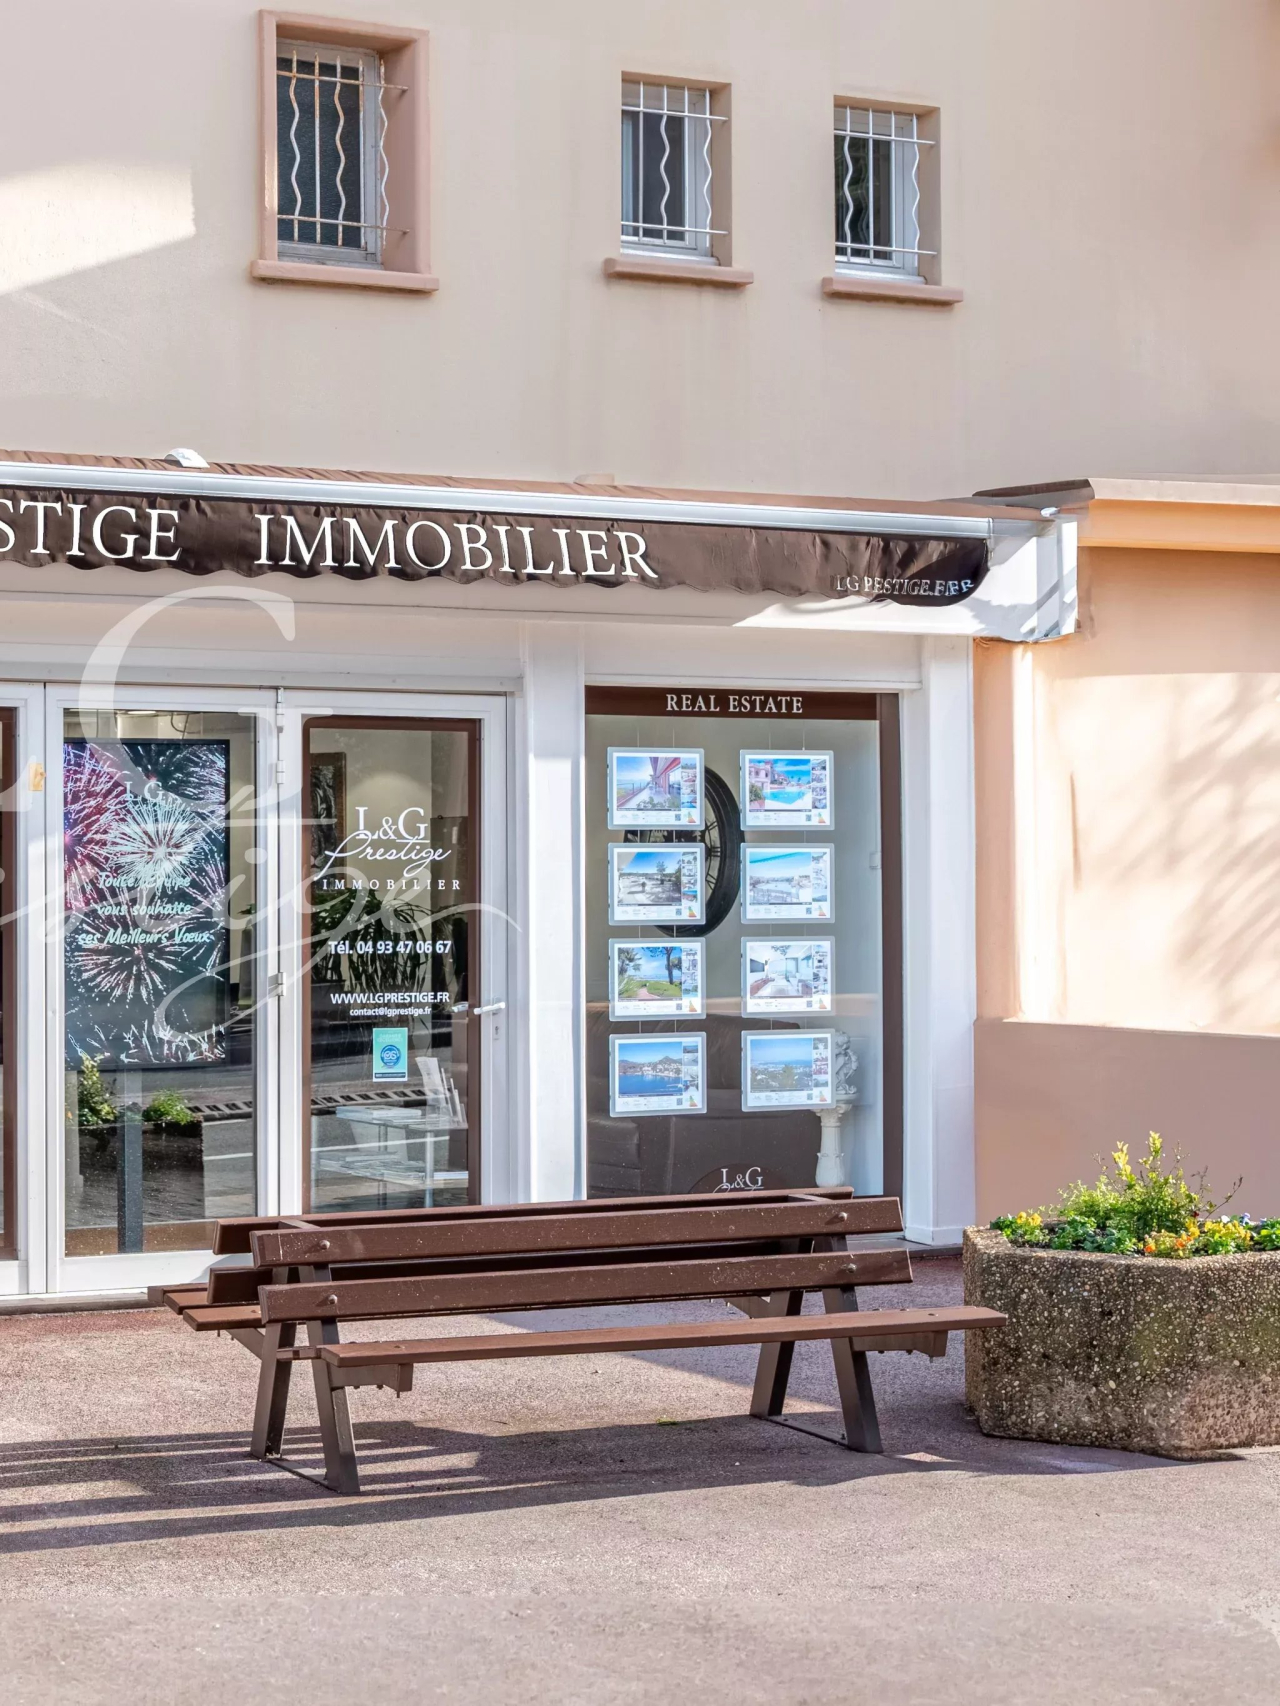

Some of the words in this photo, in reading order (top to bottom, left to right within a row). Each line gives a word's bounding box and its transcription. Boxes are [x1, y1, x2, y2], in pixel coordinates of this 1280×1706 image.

[253, 513, 659, 579] IMMOBILIER
[665, 694, 720, 713] REAL
[728, 695, 803, 714] ESTATE
[355, 806, 430, 842] L&G
[313, 830, 452, 881] Prestige
[99, 871, 136, 889] Toute
[322, 879, 461, 890] IMMOBILIER
[97, 904, 128, 916] vous
[132, 899, 192, 916] souhaite
[77, 934, 101, 946] ses
[104, 927, 169, 945] Meilleurs
[328, 941, 353, 954] Tél.
[356, 941, 373, 954] 04
[376, 941, 393, 954] 93
[396, 941, 413, 954] 47
[416, 941, 432, 954] 06
[435, 940, 452, 953] 67
[330, 991, 450, 1005] WWW.LGPRESTIGE.FR
[349, 1006, 432, 1017] contact@lgprestige.fr
[720, 1166, 764, 1189] L&G
